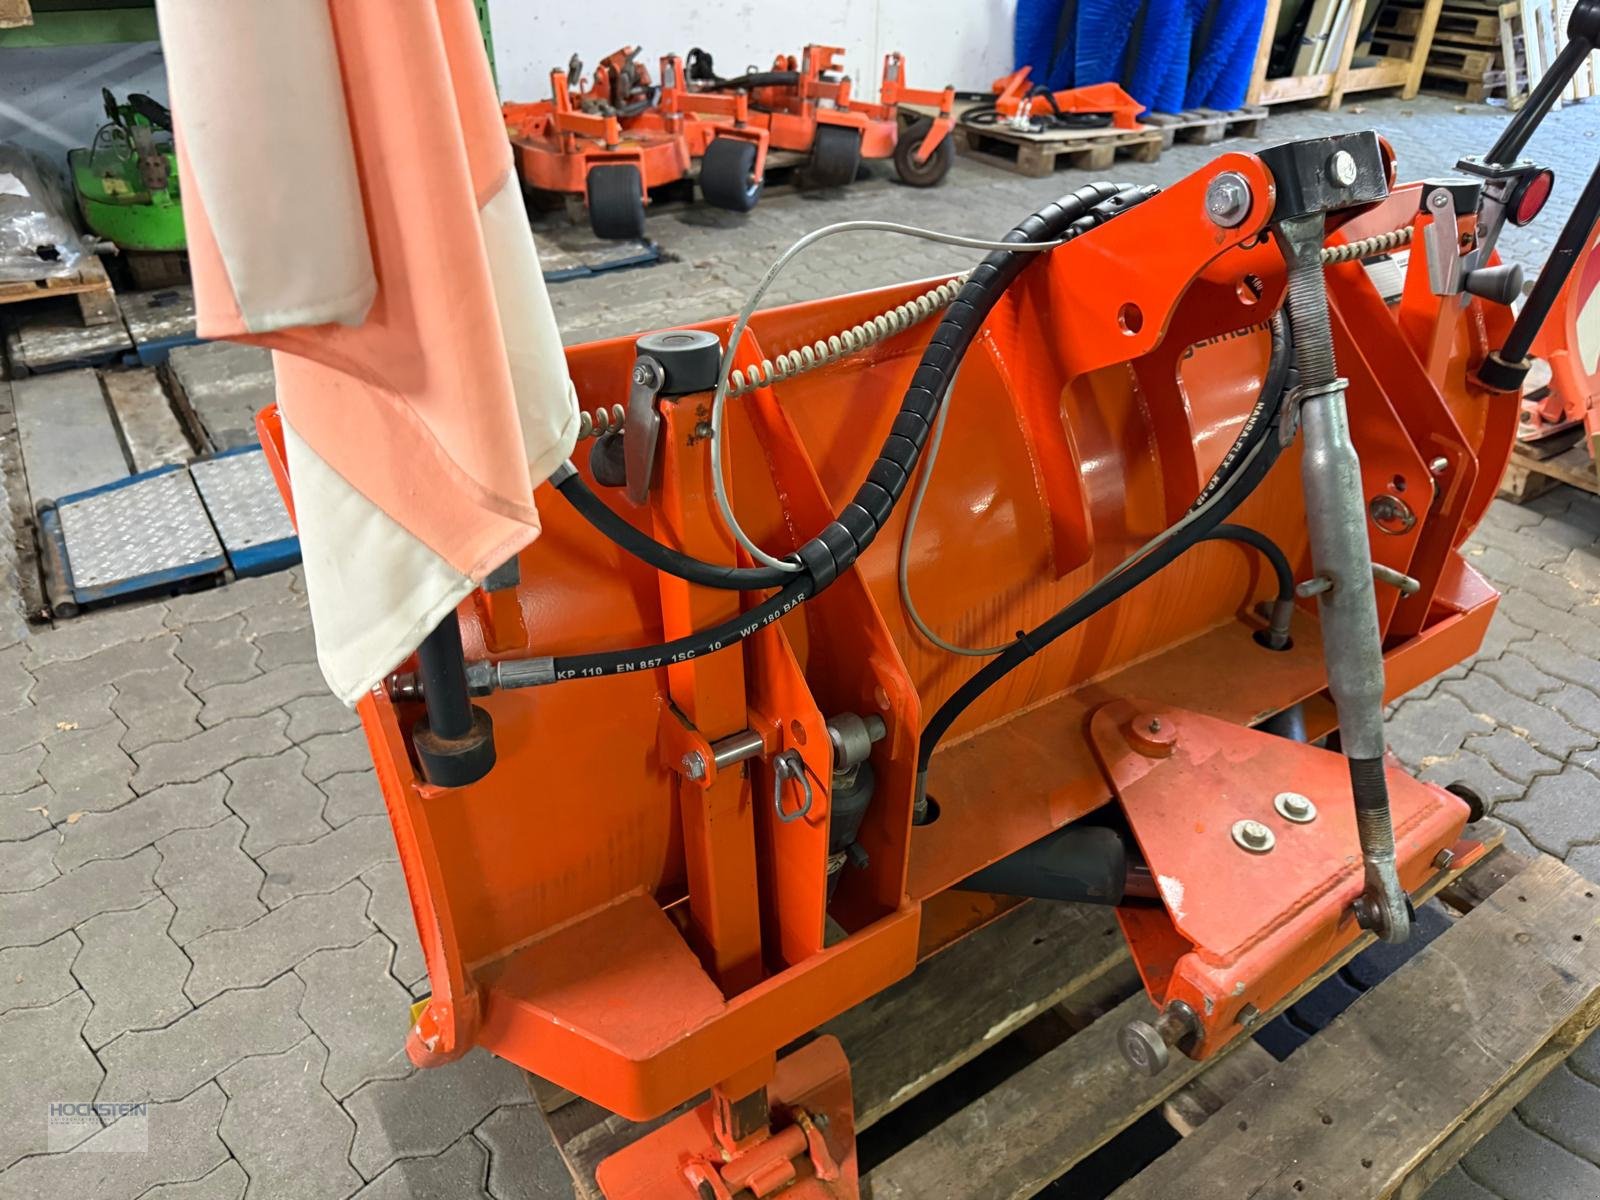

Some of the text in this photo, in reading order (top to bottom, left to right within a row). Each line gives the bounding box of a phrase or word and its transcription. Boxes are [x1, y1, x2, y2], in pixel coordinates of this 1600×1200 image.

[557, 592, 806, 680] KP 110 EN 857 1SC 10 WP 180 BAR
